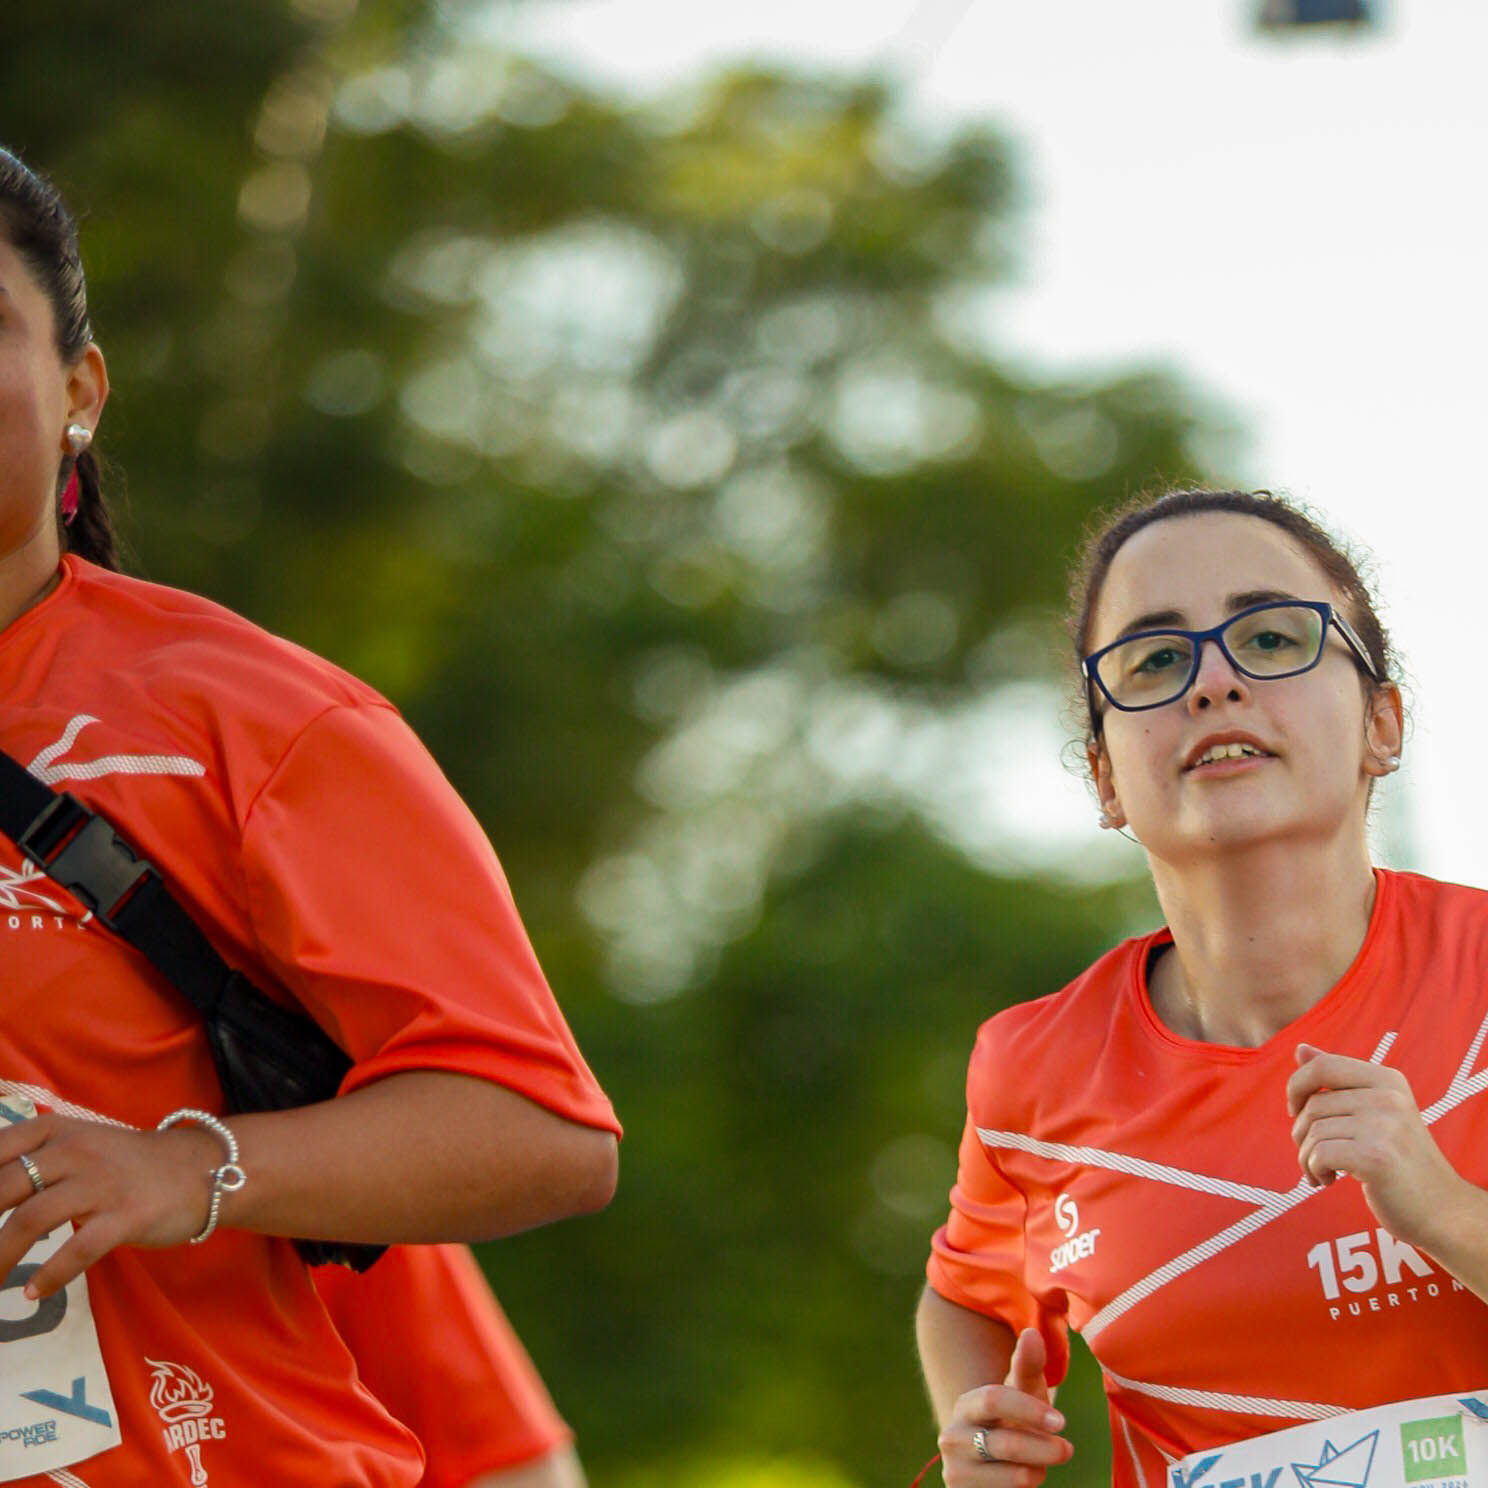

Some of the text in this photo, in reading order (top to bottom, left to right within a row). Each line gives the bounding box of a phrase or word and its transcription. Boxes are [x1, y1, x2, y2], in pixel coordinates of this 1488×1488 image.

[1307, 1227, 1434, 1300] 15K
[1329, 1283, 1440, 1320] PUERTO
[1407, 1434, 1459, 1464] 10K
